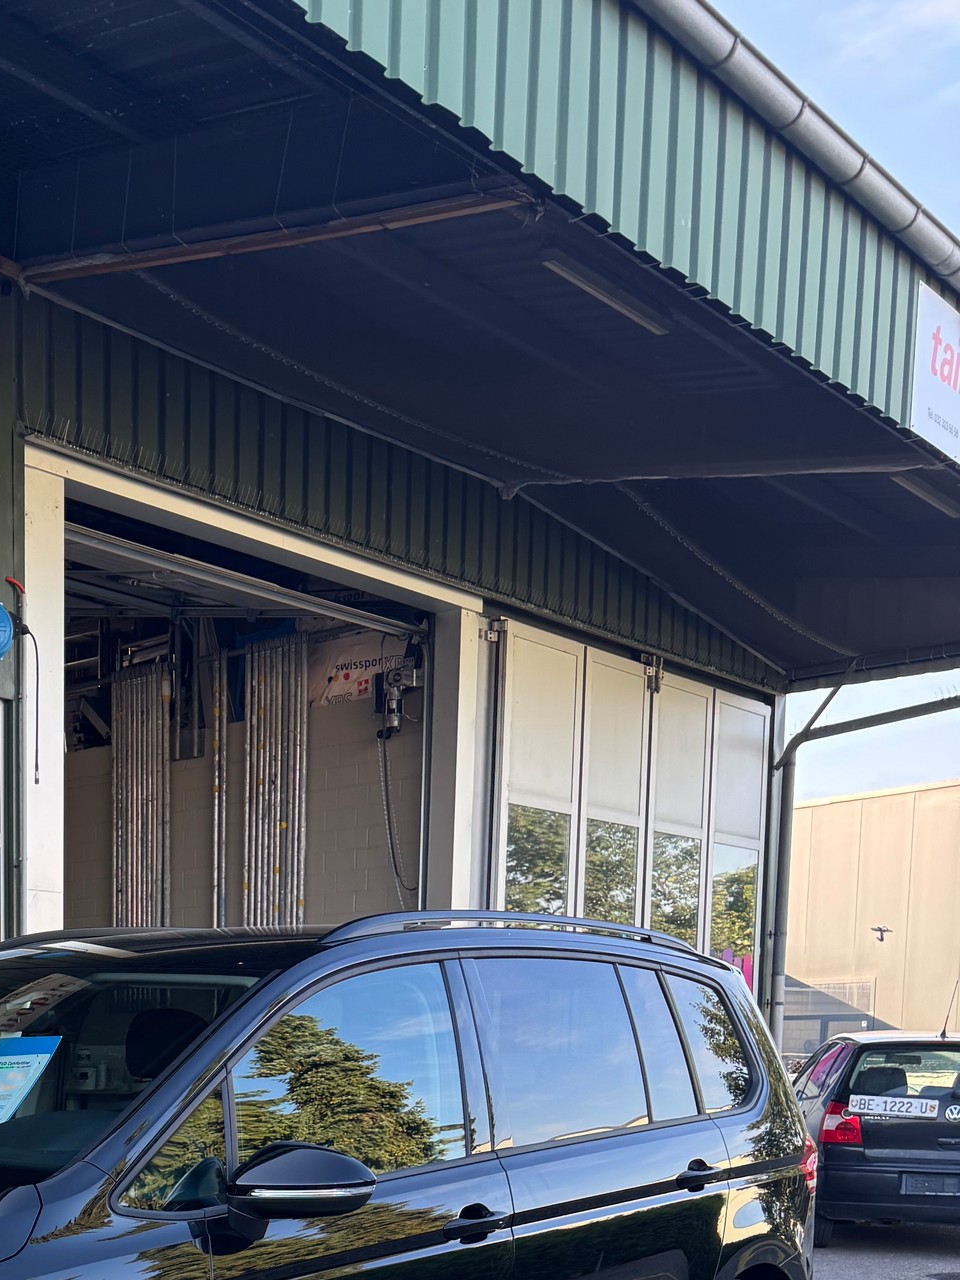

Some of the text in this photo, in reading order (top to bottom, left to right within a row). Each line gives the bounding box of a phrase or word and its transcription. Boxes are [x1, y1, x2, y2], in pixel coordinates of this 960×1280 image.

[335, 657, 382, 673] swisspor
[858, 1098, 928, 1114] BE 1222 U
